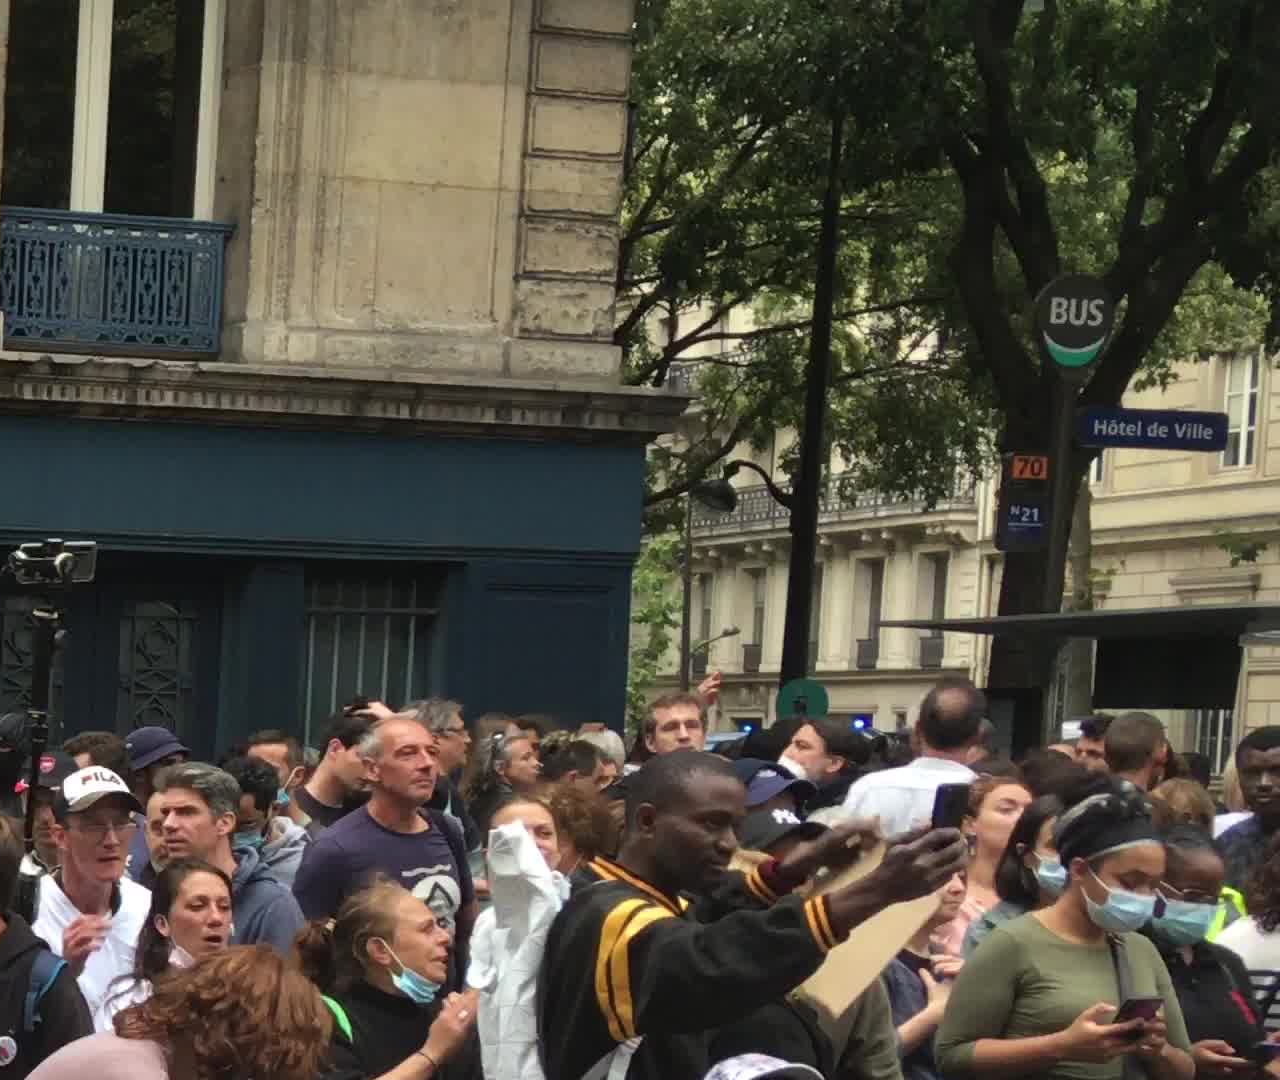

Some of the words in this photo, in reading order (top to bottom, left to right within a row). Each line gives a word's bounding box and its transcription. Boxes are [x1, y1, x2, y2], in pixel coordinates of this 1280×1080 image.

[1050, 297, 1104, 326] BUS
[1093, 418, 1142, 437] Hôtel
[1147, 420, 1169, 438] de
[1175, 422, 1214, 440] Ville
[1017, 457, 1044, 477] 70
[81, 771, 121, 785] FILA
